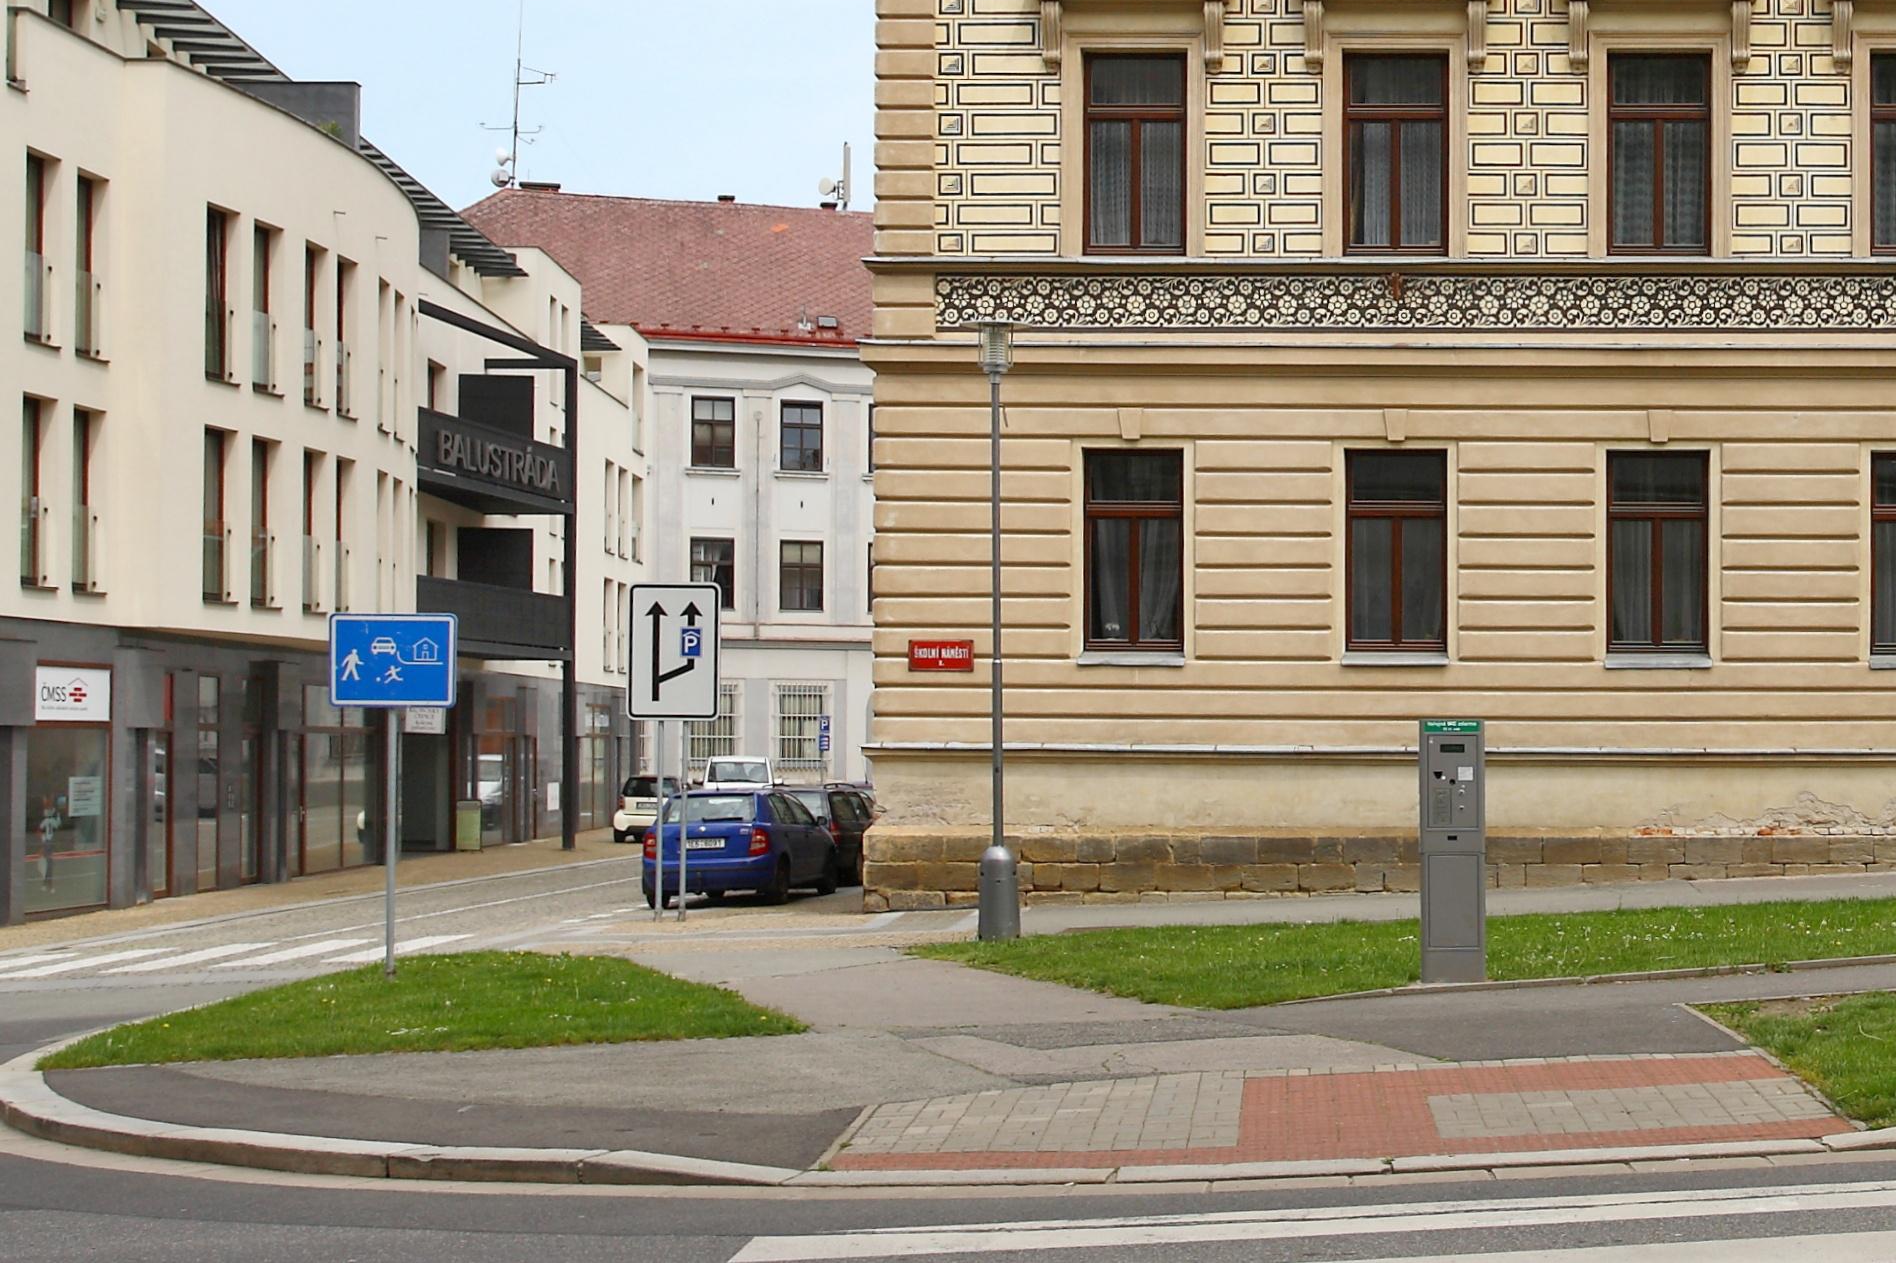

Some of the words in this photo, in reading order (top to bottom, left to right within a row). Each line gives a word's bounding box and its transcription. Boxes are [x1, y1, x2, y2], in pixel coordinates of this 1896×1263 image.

[439, 429, 560, 493] BALUSTRÁDA
[684, 636, 698, 653] P
[914, 646, 939, 658] ŠKOLNÍ
[941, 646, 969, 658] NÁMĚSTÍ
[41, 681, 67, 702] ČMSS
[821, 719, 829, 730] P
